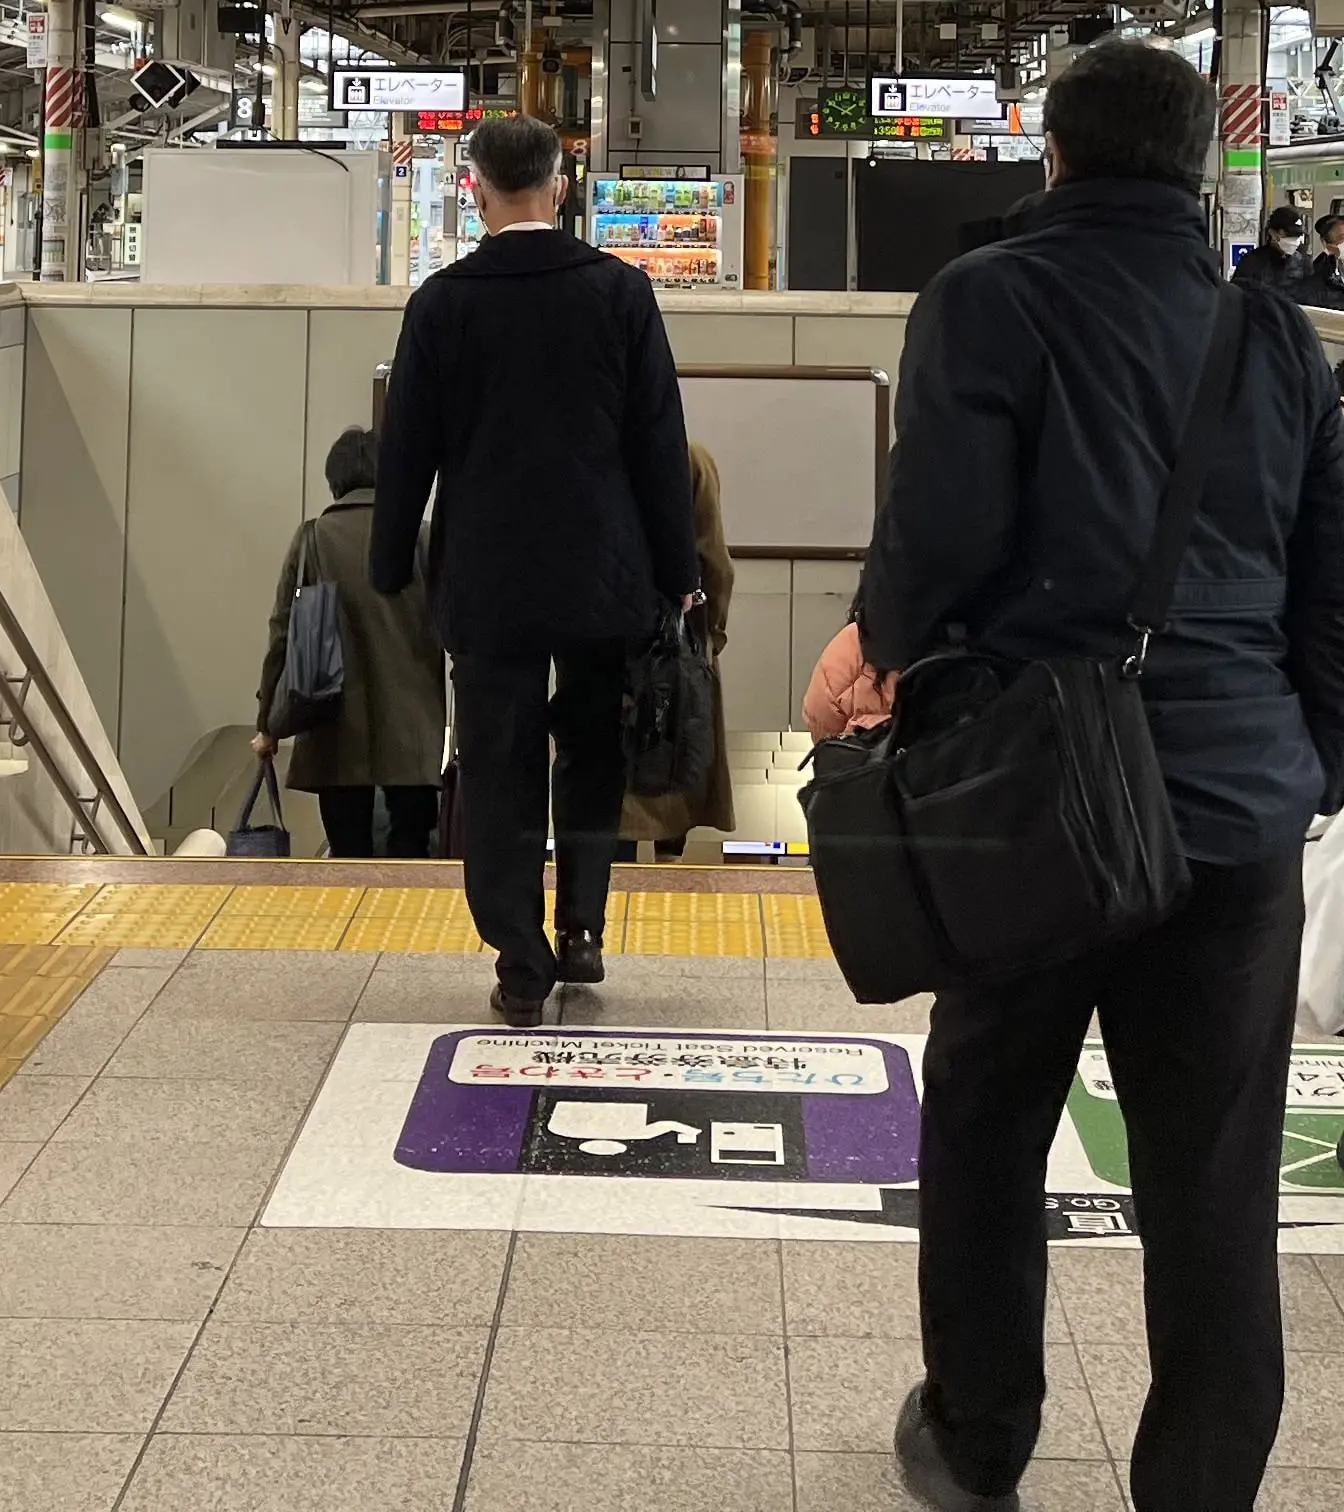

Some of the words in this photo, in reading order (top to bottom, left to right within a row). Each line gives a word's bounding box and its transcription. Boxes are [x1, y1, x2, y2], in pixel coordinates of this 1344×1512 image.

[373, 77, 458, 93] エレベーター
[910, 84, 994, 100] エレベーター
[373, 95, 415, 105] Elevator
[236, 97, 253, 119] 8
[398, 167, 405, 177] 2
[476, 1038, 585, 1051] Machine
[600, 1040, 662, 1053] Ticket
[674, 1042, 730, 1055] Seat
[743, 1044, 864, 1057] Reserved
